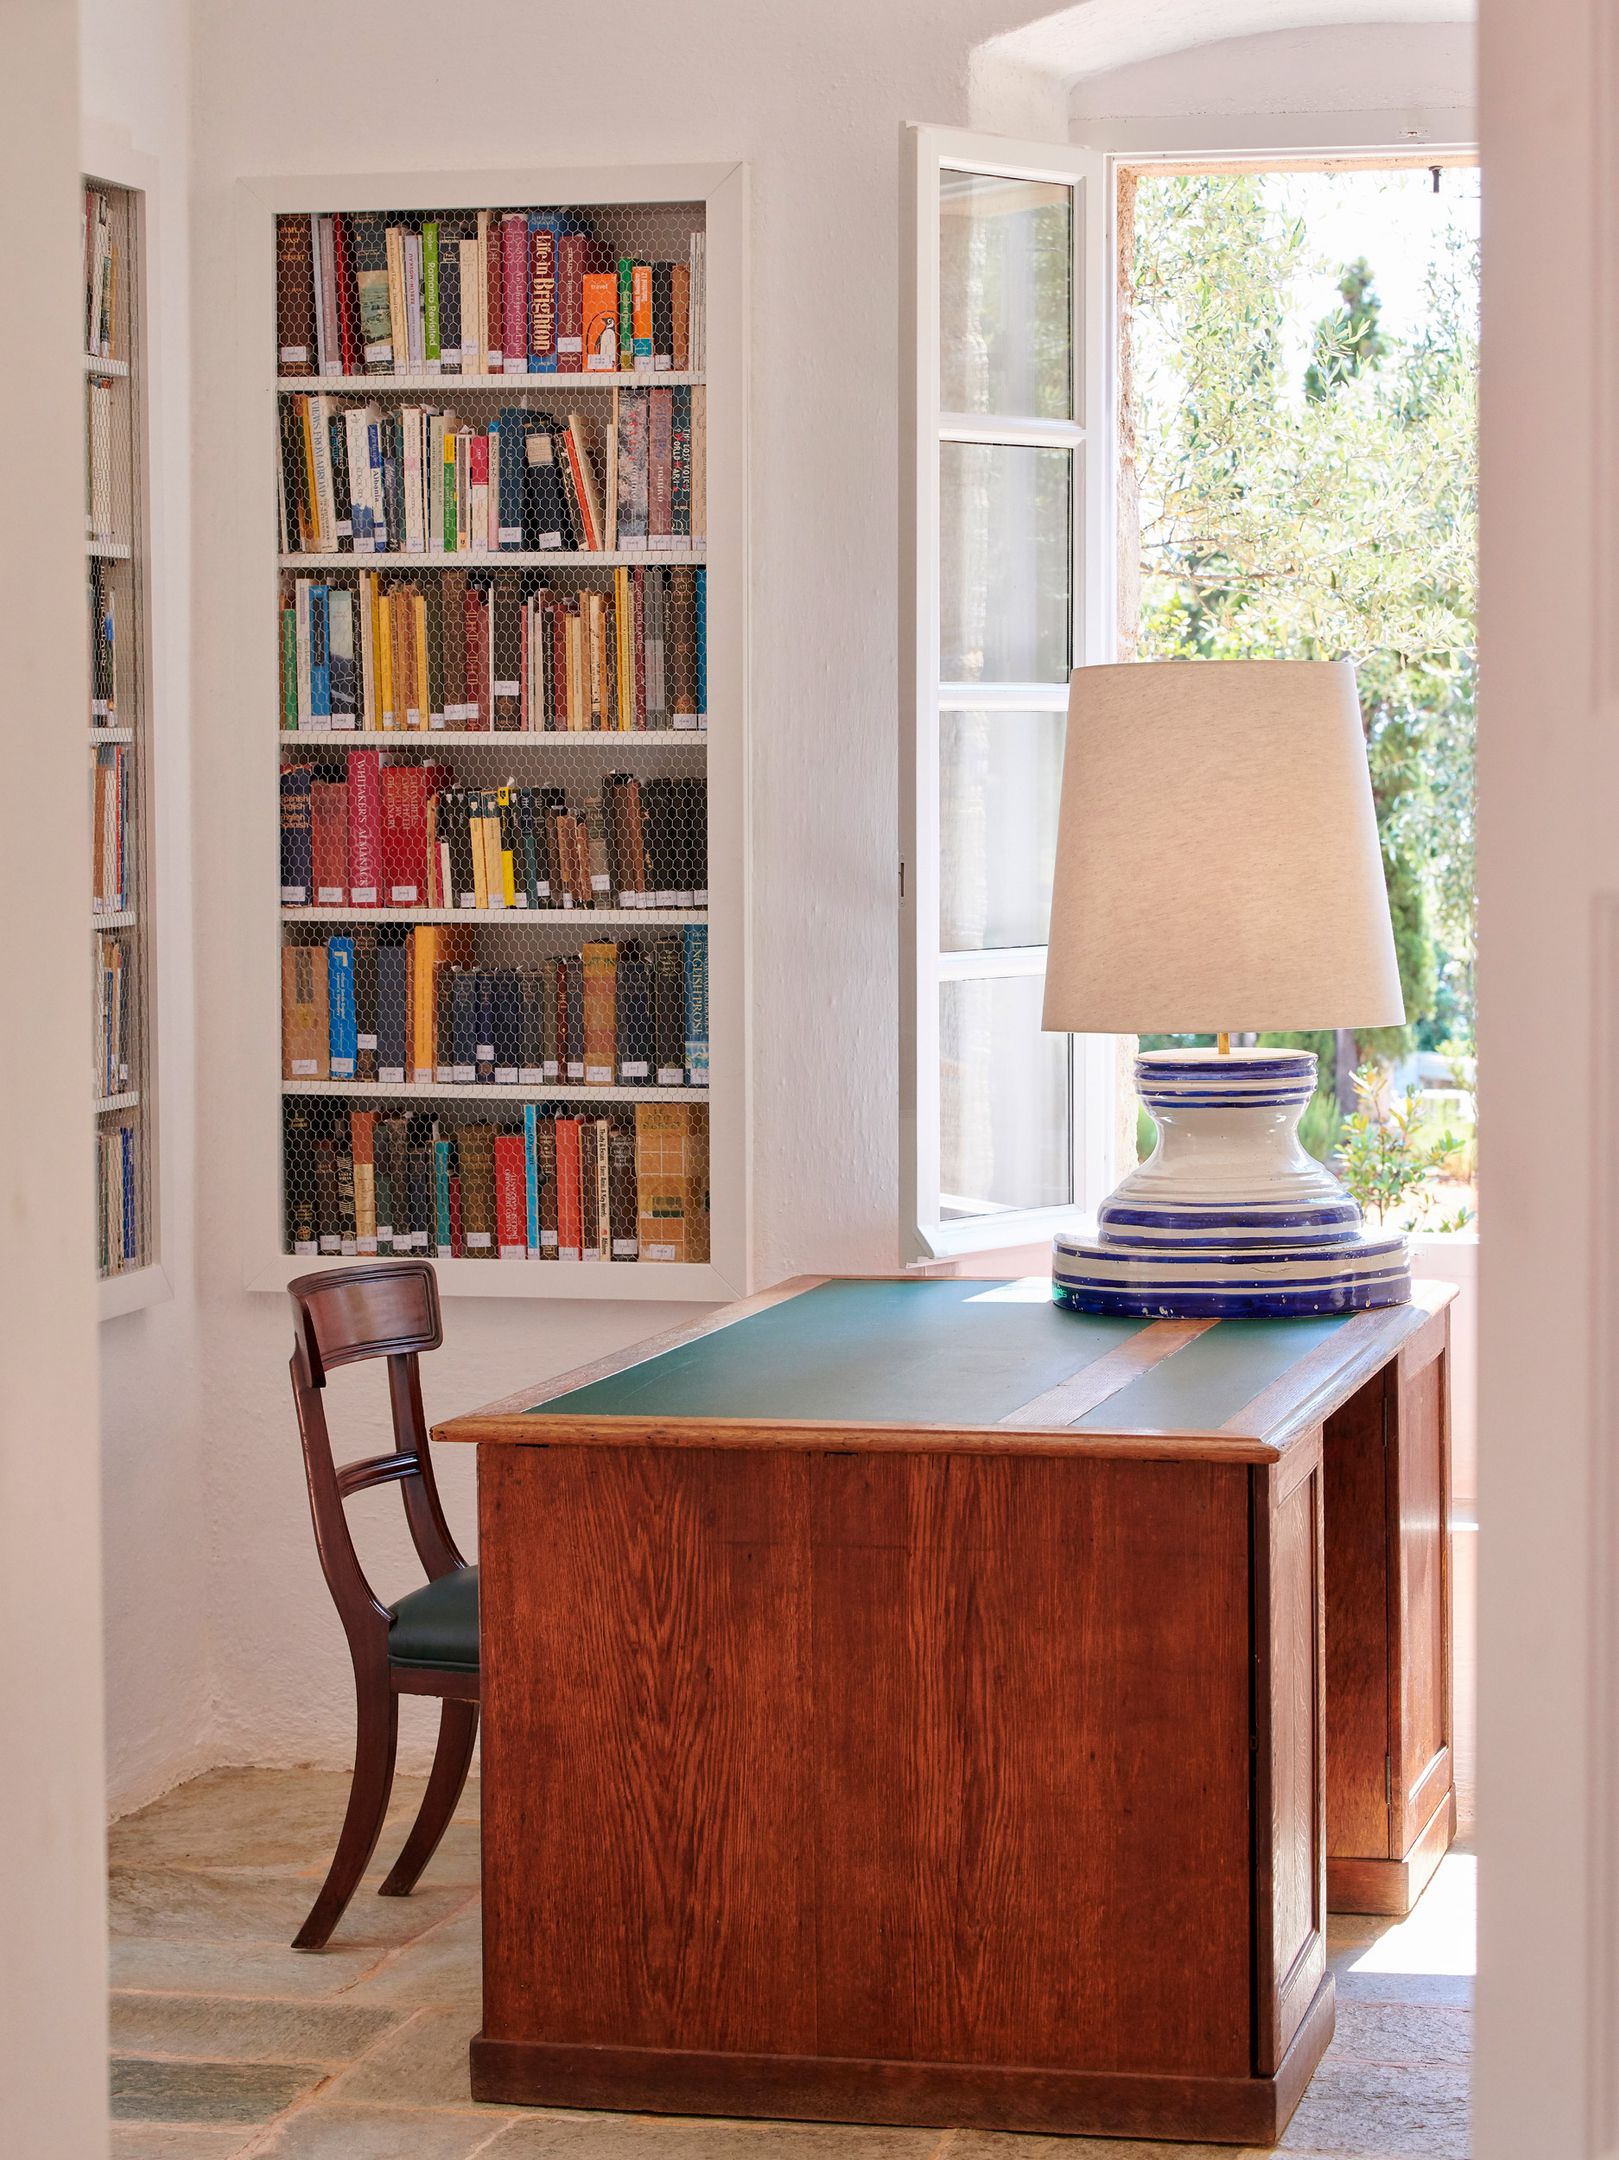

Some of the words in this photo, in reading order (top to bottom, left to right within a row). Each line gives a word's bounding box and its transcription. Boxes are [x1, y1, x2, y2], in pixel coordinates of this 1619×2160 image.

[536, 235, 551, 259] Life
[428, 262, 436, 304] Romania
[536, 262, 550, 274] in
[590, 282, 608, 290] travel
[428, 306, 437, 346] Revisited
[533, 278, 554, 350] Brighton
[312, 400, 321, 430] VIEWS
[313, 432, 324, 457] FROM
[316, 460, 326, 497] ABROAD
[682, 464, 690, 492] VOICS
[357, 760, 367, 824] WHITAKER'S
[692, 942, 702, 994] ENGLISH
[692, 996, 702, 1035] PROSE
